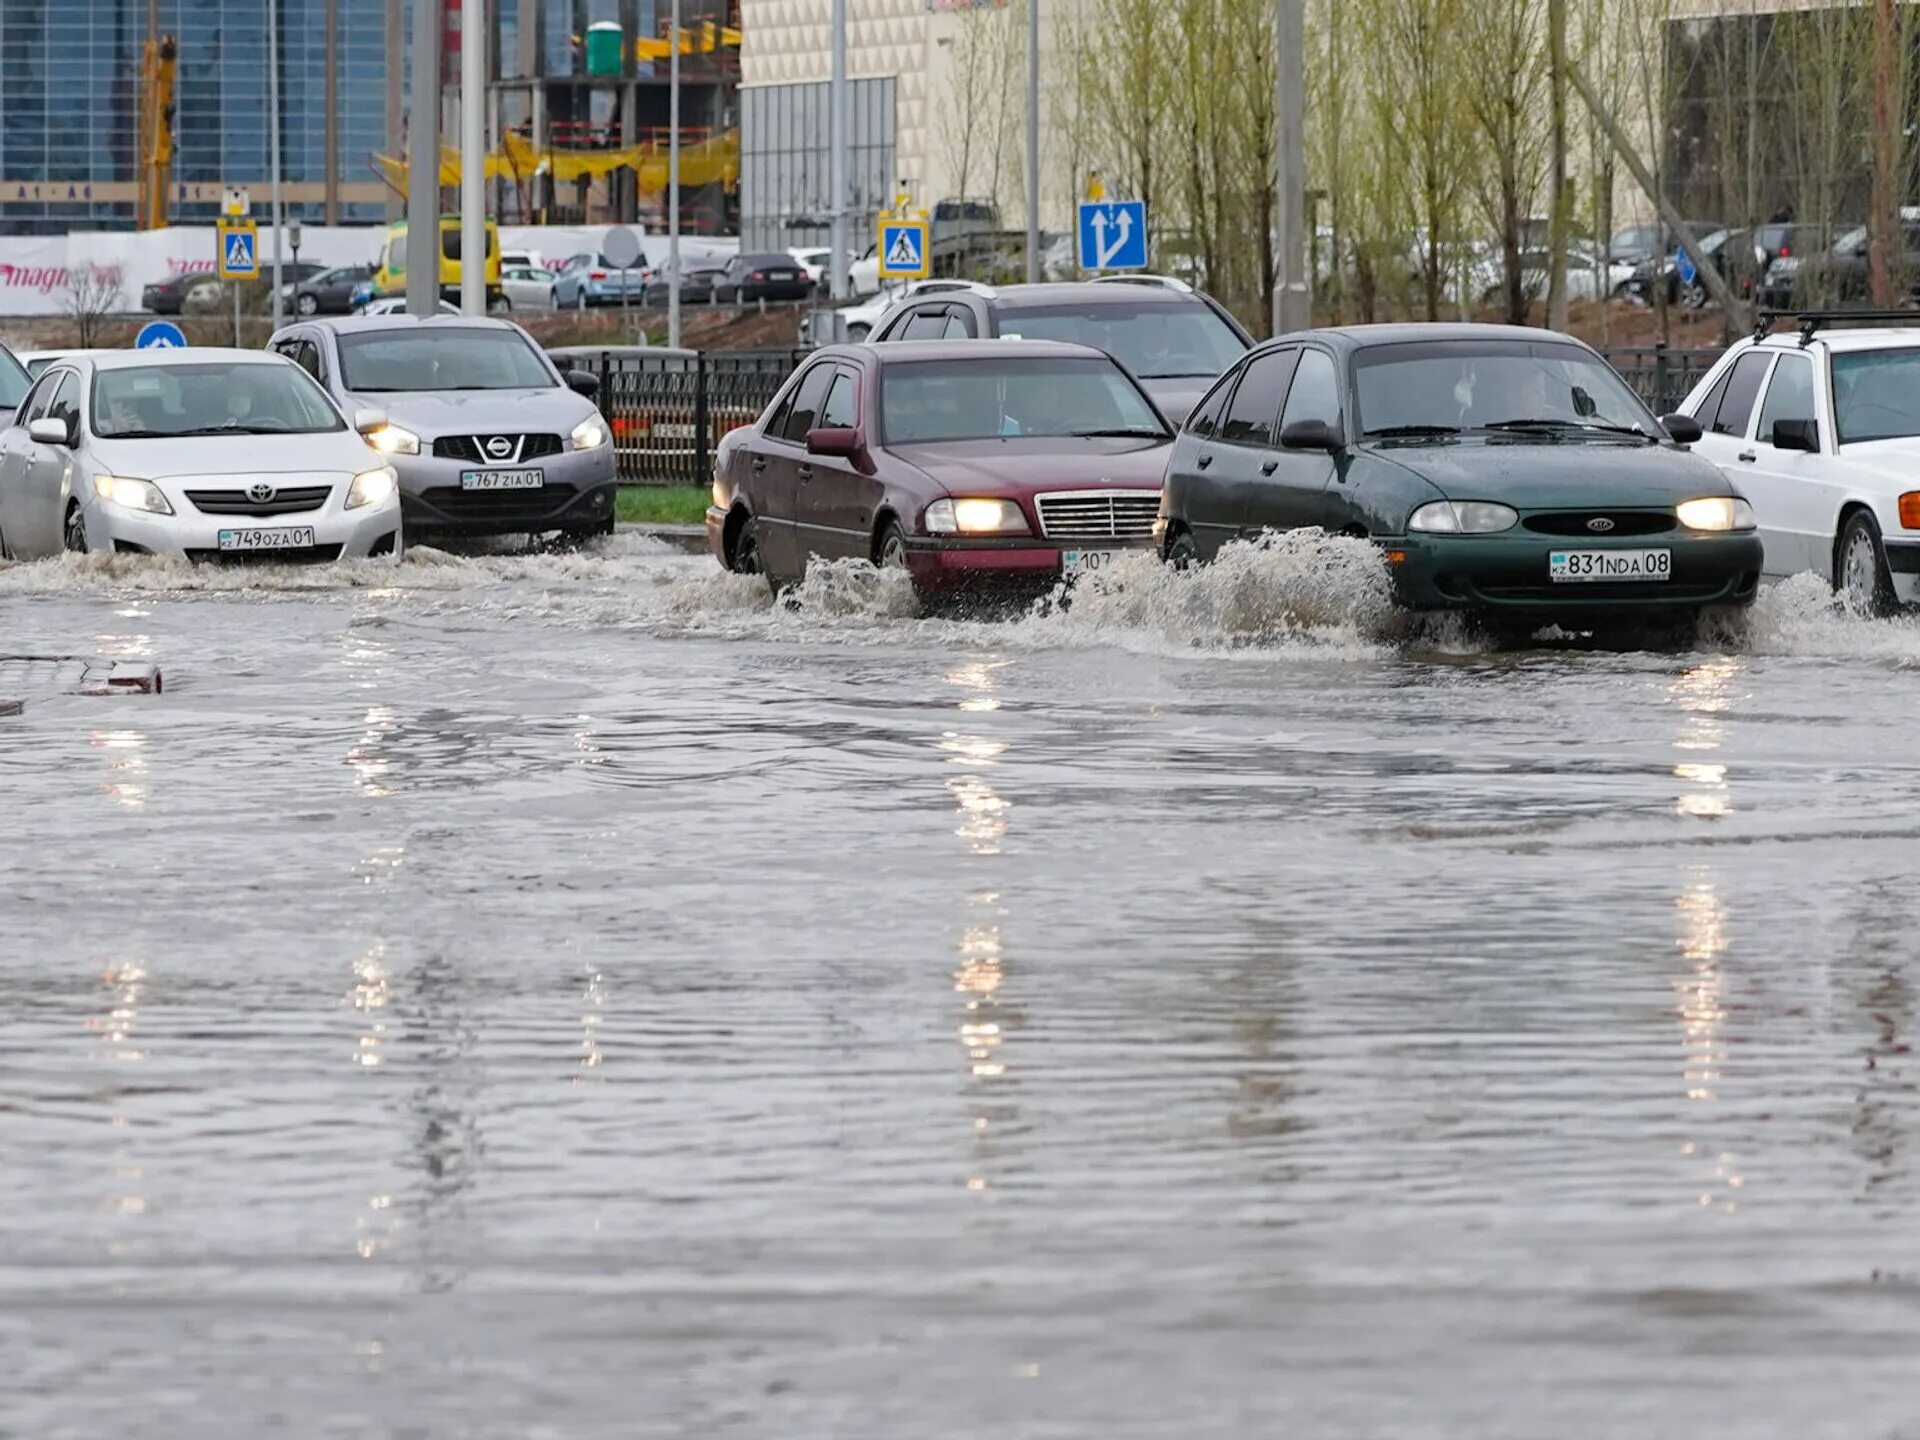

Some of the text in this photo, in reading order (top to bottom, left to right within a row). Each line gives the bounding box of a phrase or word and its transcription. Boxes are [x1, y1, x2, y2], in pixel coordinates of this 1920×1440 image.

[475, 472, 499, 487] 767
[526, 471, 541, 485] 01
[293, 529, 312, 545] 01
[1081, 552, 1111, 570] 107
[1552, 566, 1566, 575] KZ
[1646, 553, 1669, 573] 08
